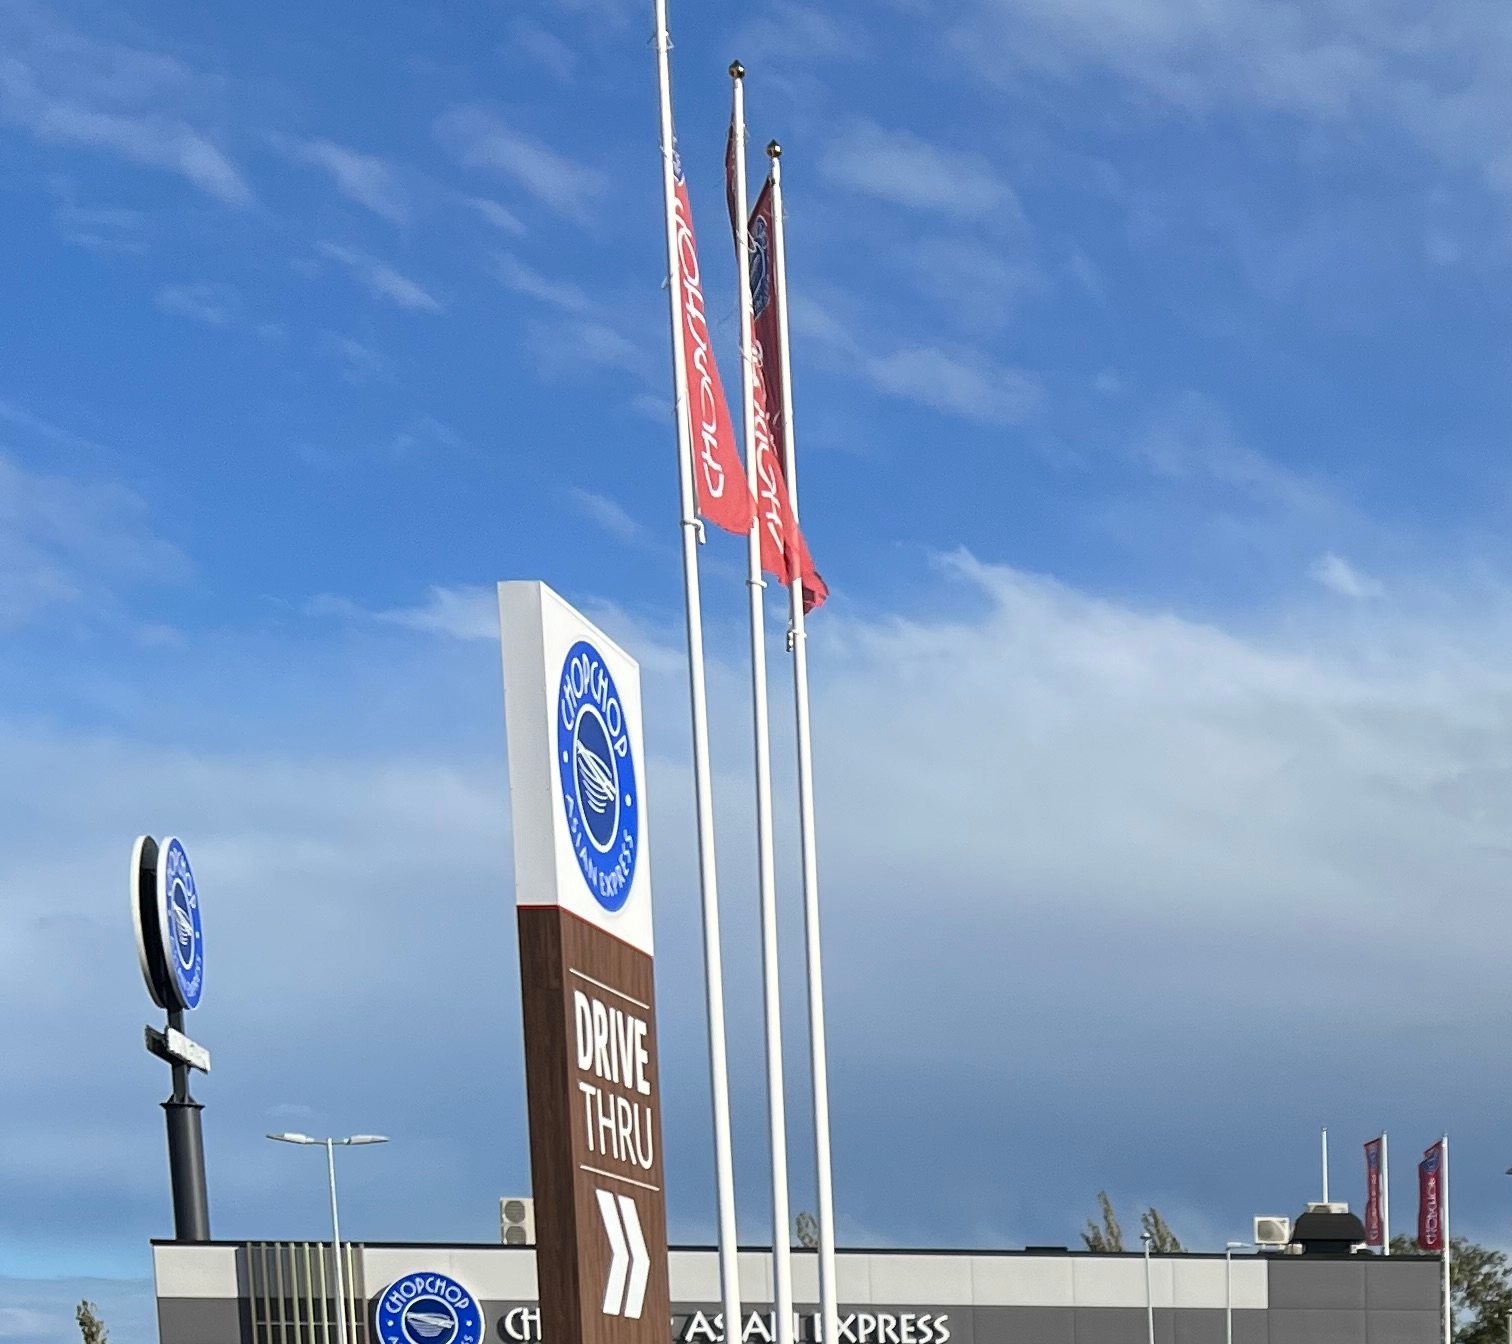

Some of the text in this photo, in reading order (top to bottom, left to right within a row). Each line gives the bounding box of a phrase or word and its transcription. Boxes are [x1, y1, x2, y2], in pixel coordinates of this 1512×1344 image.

[560, 653, 628, 759] CHOPCHOP
[599, 828, 635, 898] EXPRESS
[572, 989, 651, 1096] DRIVE
[577, 1080, 653, 1171] THRU
[385, 1276, 471, 1315] CHOPCHOP
